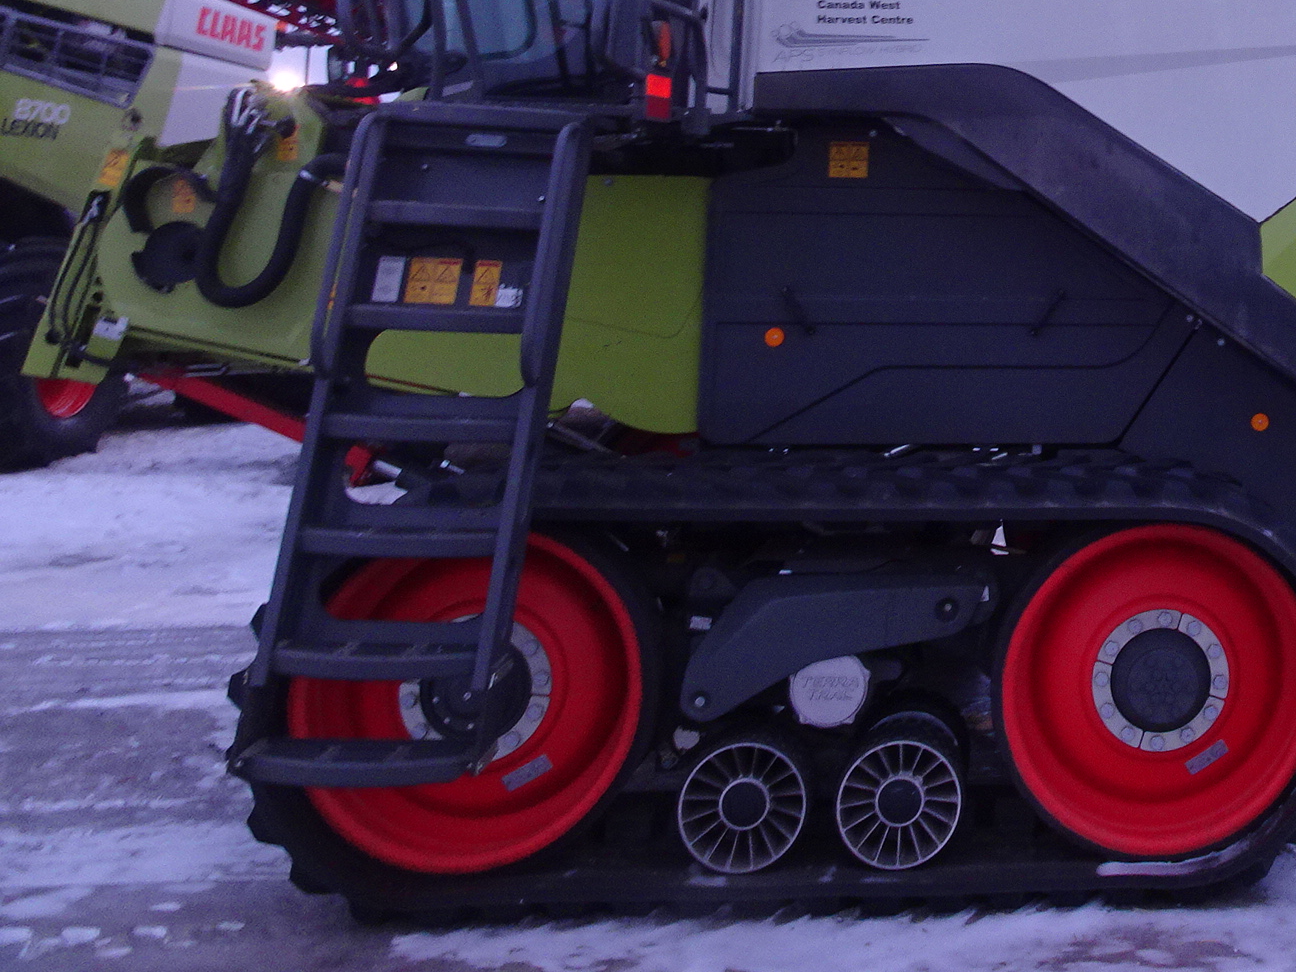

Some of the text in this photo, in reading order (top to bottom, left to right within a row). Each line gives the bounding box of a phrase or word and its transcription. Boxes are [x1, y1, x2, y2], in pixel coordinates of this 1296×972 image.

[817, 0, 901, 10] Canada West
[816, 14, 914, 25] Harvest Centre
[196, 6, 267, 52] CLAAS
[13, 98, 71, 124] 8700
